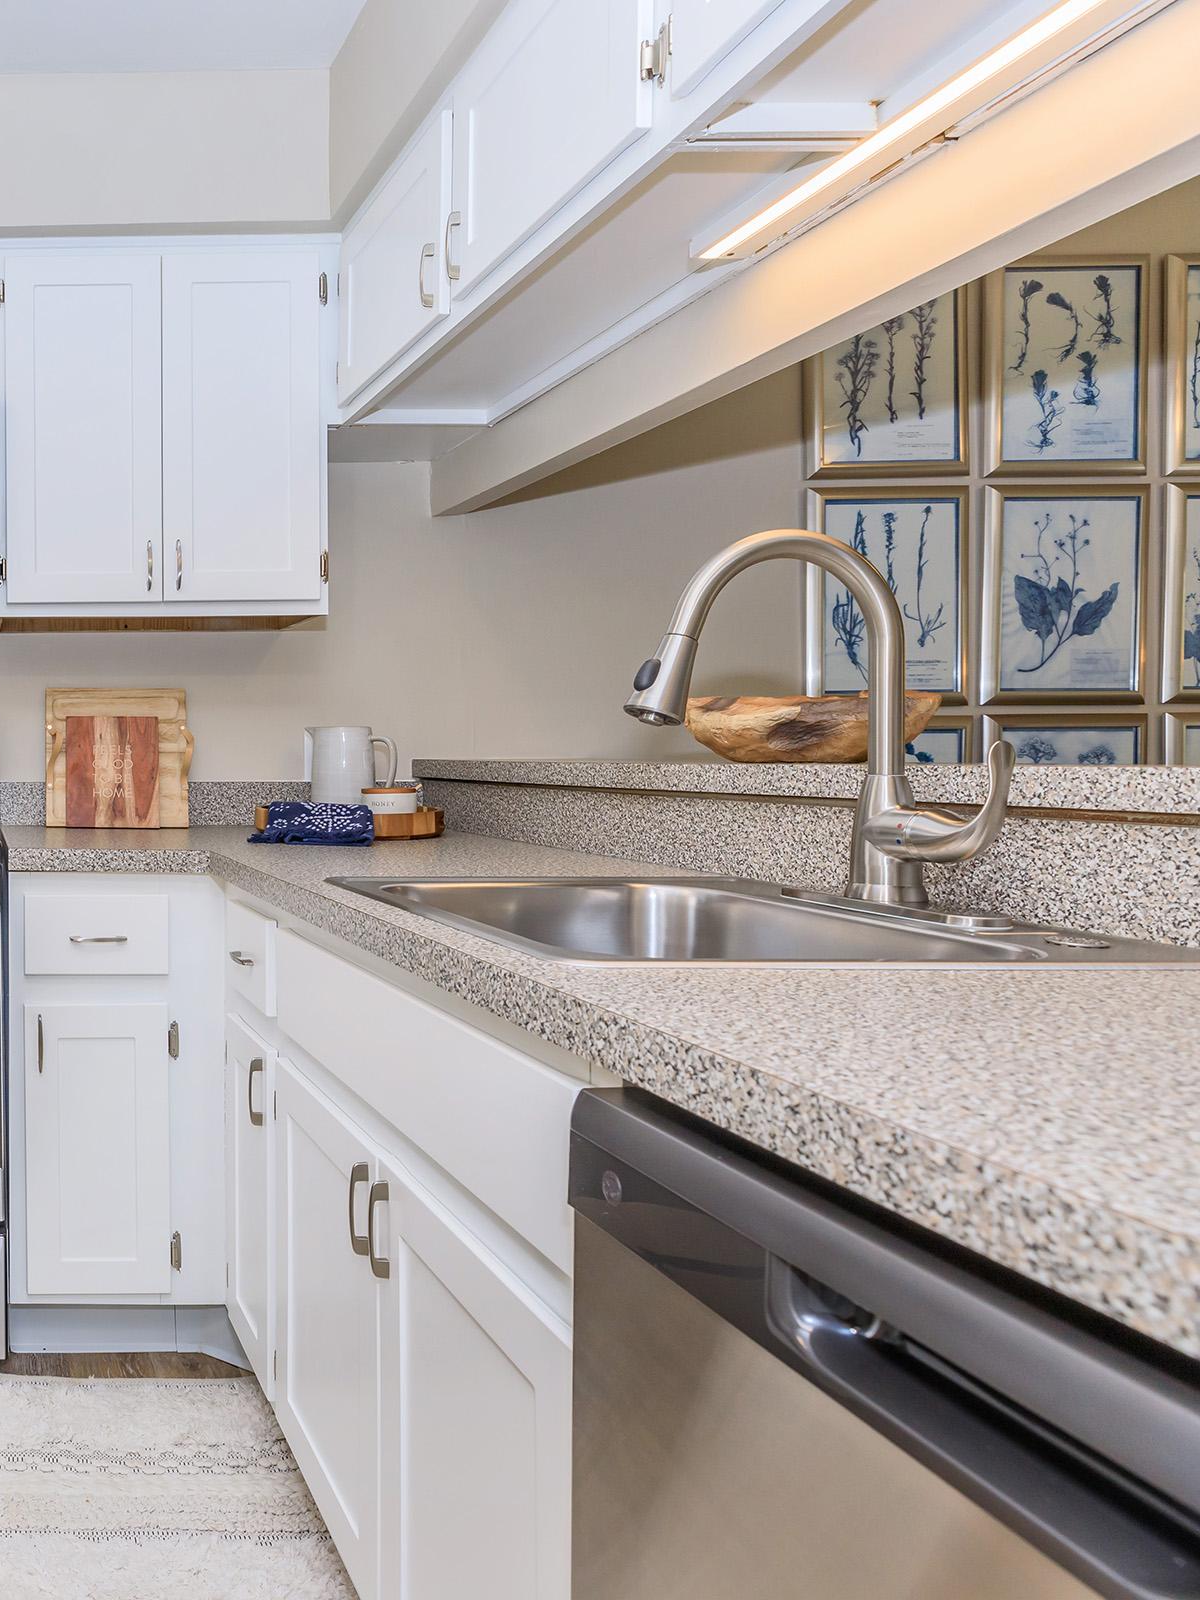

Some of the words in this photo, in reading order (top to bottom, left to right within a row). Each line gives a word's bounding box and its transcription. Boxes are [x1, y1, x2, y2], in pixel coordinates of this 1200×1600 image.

[92, 744, 132, 756] FEELS
[92, 773, 110, 783] TO
[92, 787, 133, 798] HOME
